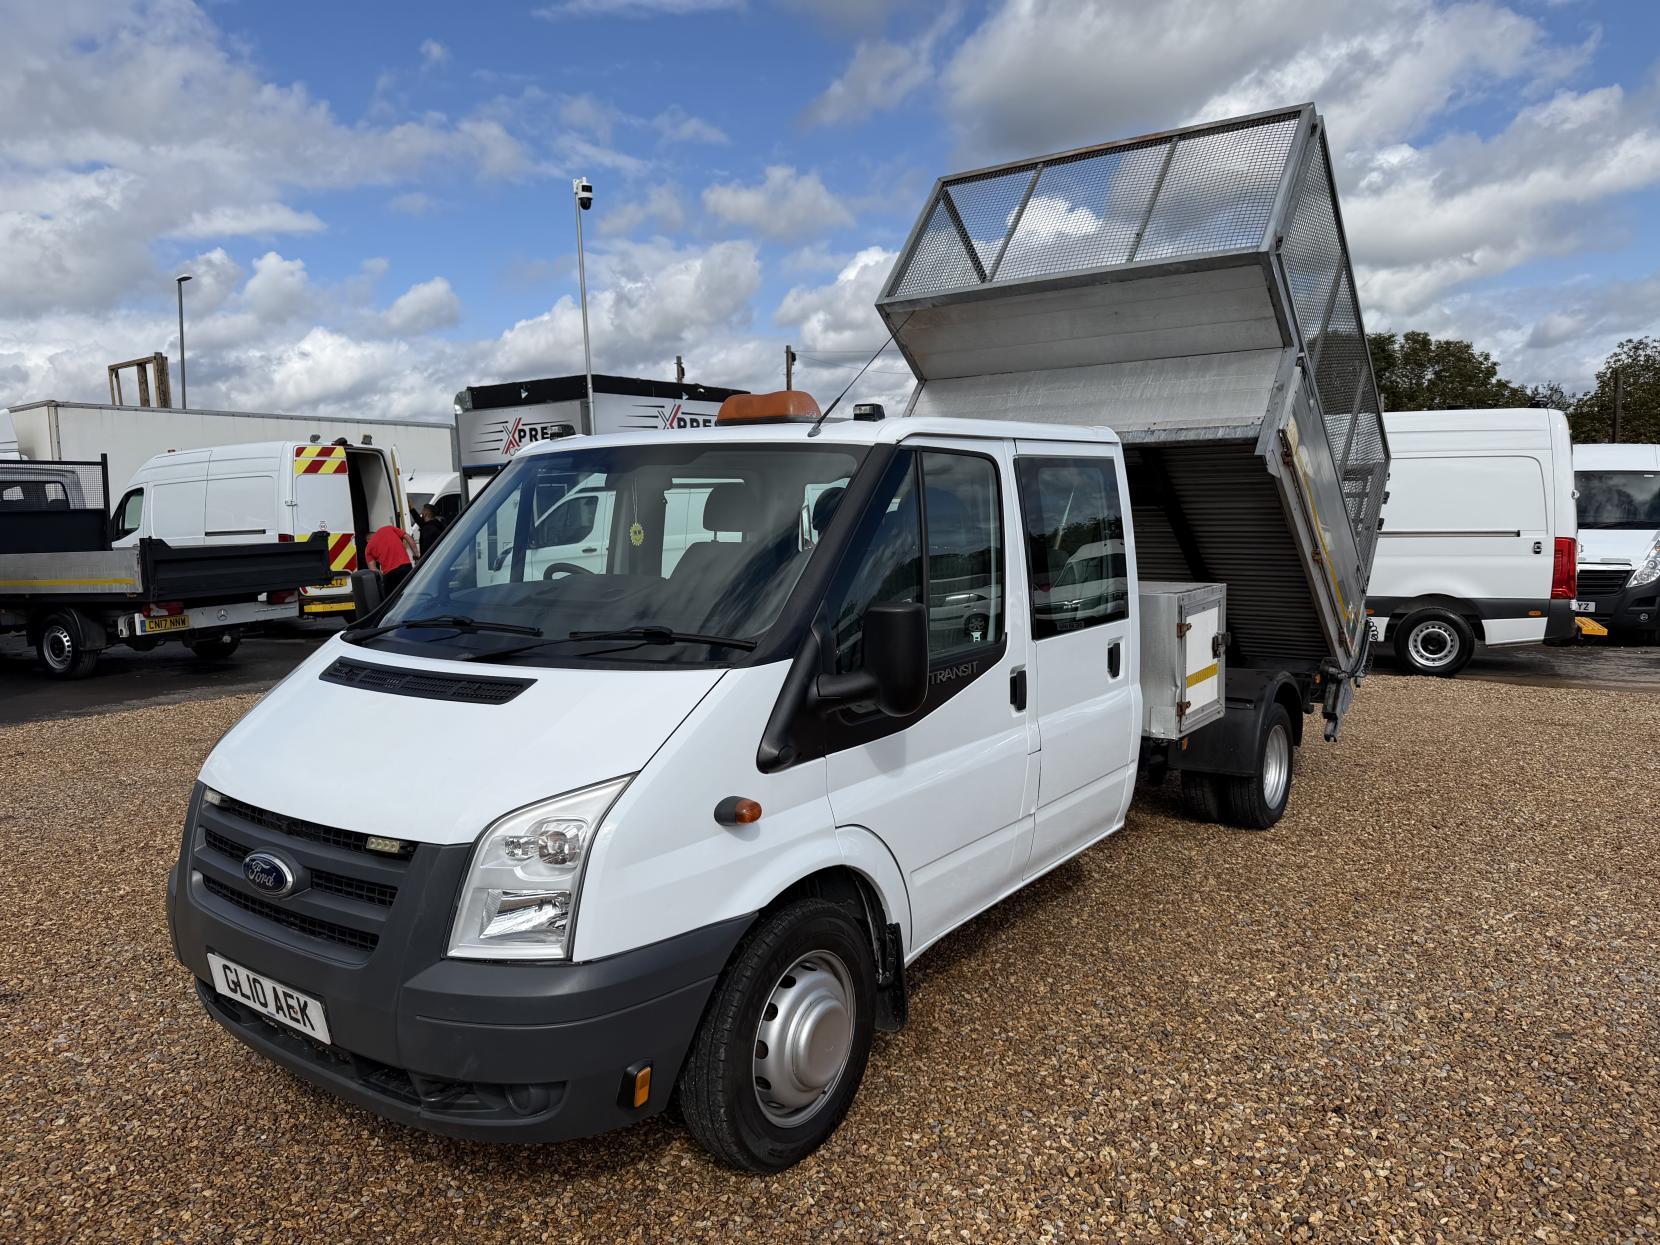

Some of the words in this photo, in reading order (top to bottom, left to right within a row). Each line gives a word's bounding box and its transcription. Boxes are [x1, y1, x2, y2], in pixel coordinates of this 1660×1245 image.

[657, 404, 713, 430] XPRE
[502, 417, 550, 455] XPRE
[148, 618, 168, 630] CN17
[929, 661, 979, 685] TRANSIT
[248, 860, 277, 887] Ford
[222, 963, 269, 1009] GL10
[272, 985, 316, 1032] AEK
